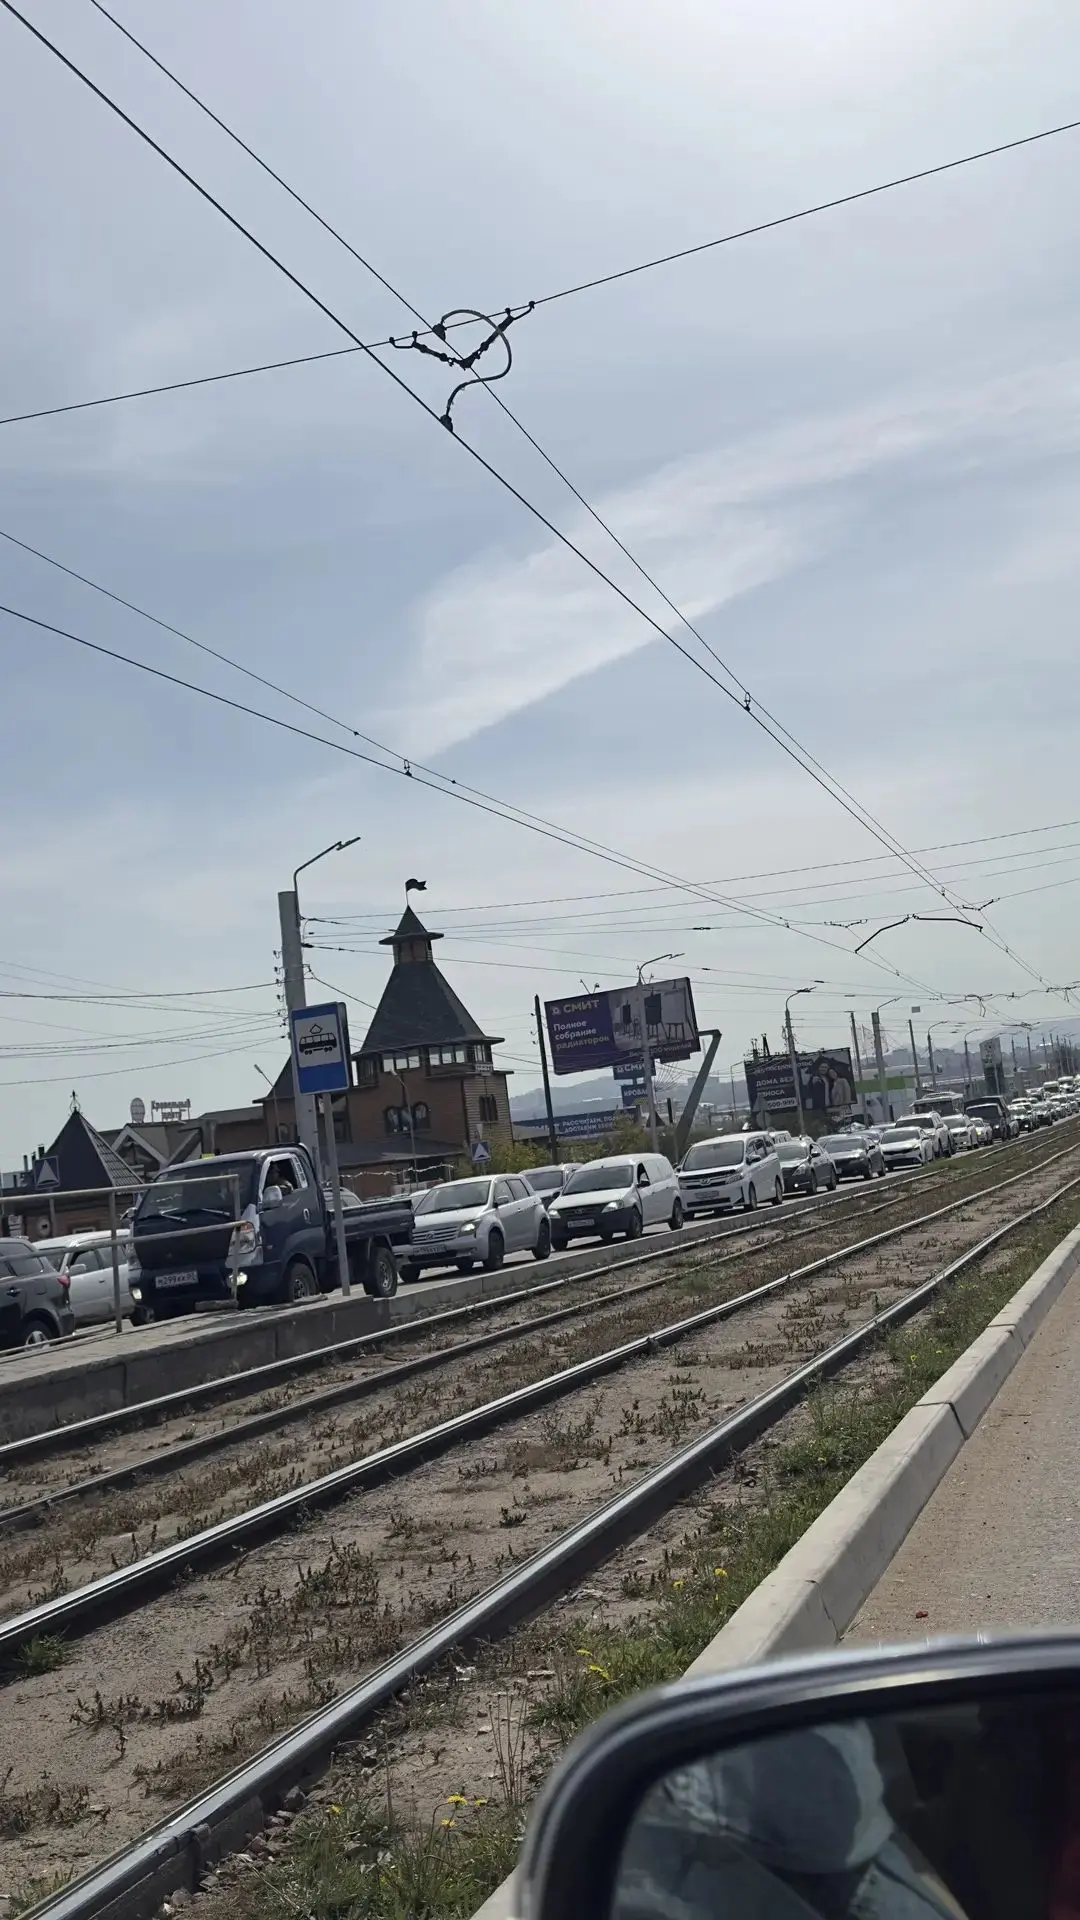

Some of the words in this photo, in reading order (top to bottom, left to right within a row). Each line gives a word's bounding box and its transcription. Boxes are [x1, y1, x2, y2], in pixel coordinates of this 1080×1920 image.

[563, 1000, 600, 1013] СМИТ
[553, 1020, 588, 1031] Полное
[555, 1028, 597, 1041] собрание
[556, 1036, 610, 1051] радиаторов
[624, 1063, 646, 1073] СМИ
[756, 1078, 779, 1087] ДОМА
[623, 1089, 648, 1097] КРОВЛ
